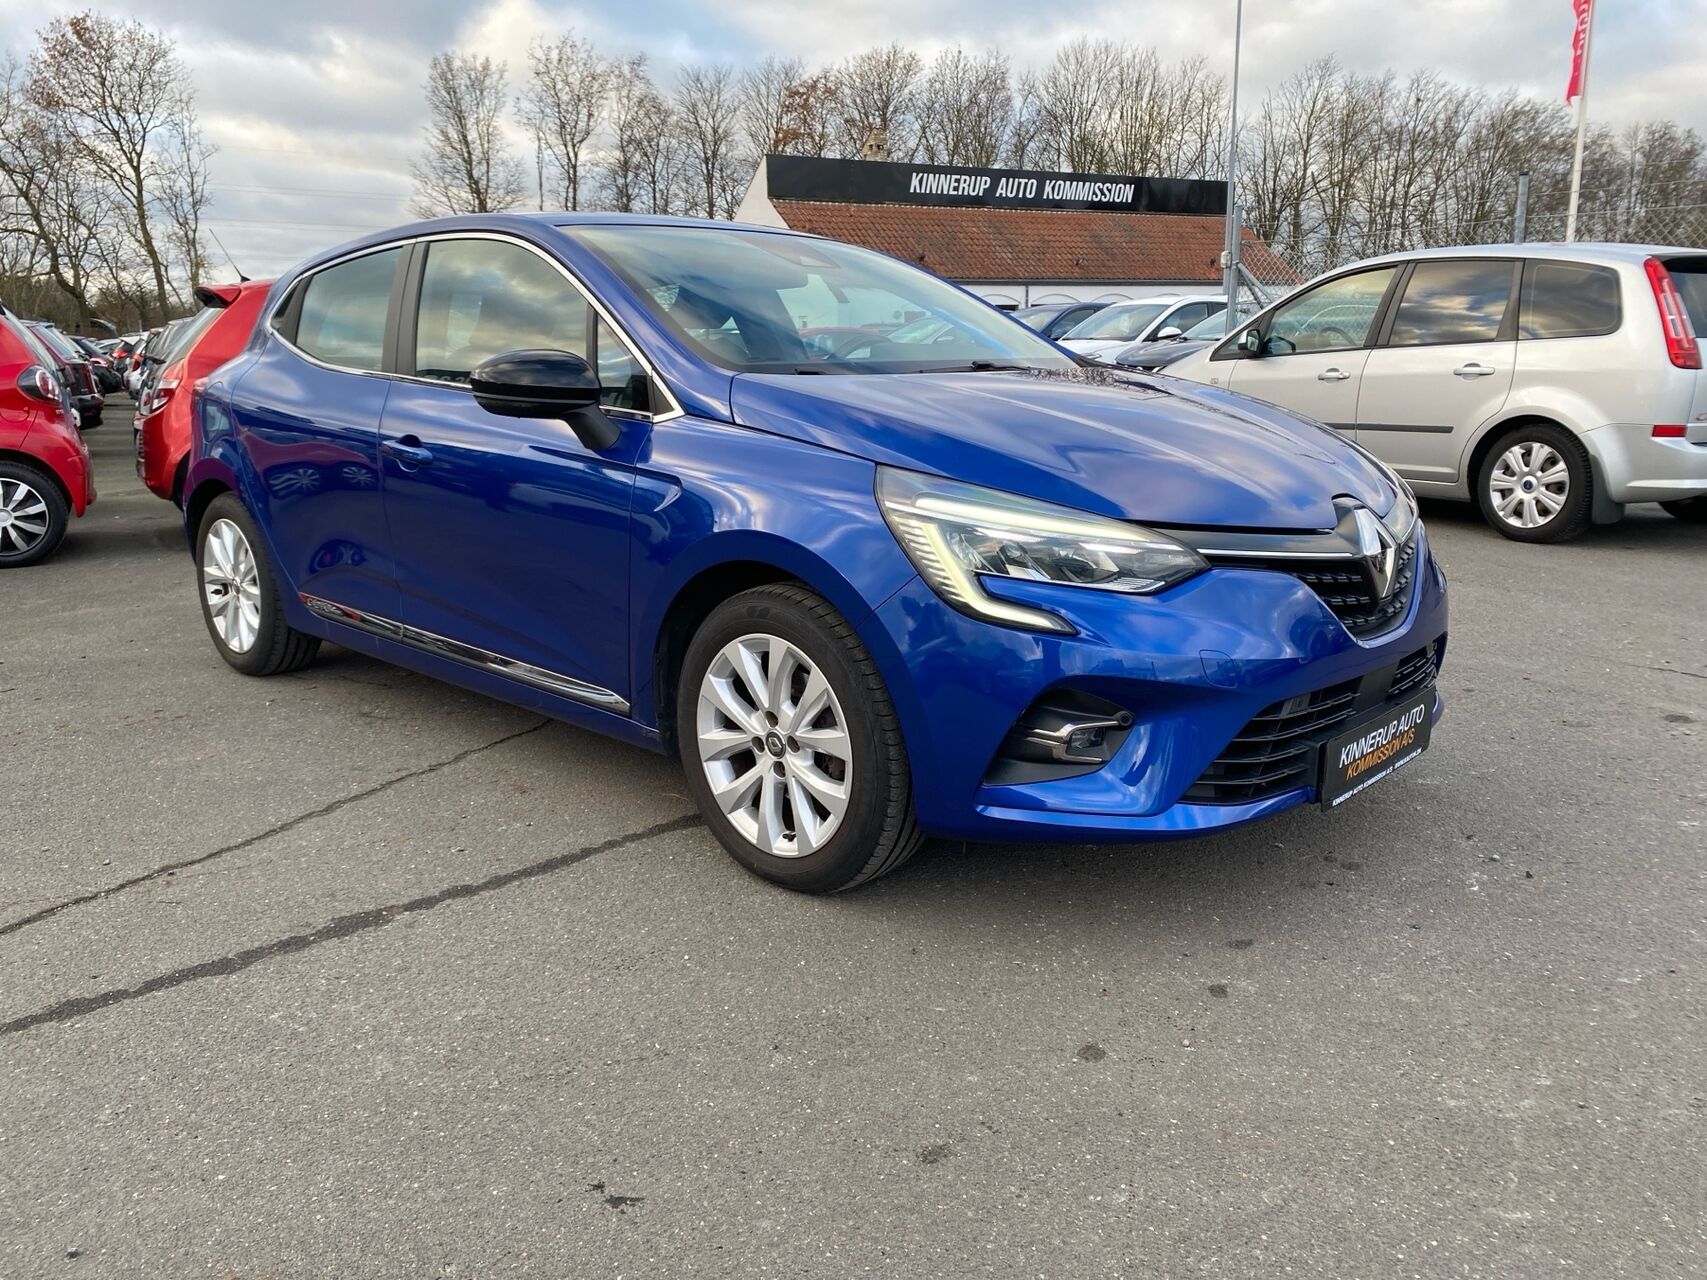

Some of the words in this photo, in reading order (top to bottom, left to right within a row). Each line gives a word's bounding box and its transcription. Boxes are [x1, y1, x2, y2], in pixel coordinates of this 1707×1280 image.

[910, 172, 991, 196] KINNERUP
[996, 177, 1037, 199] AUTO
[1043, 179, 1135, 203] KOMMISSION
[1339, 719, 1398, 768] KINNERUP
[1396, 704, 1425, 736] AUTO
[1346, 737, 1402, 780] KOMMISSION
